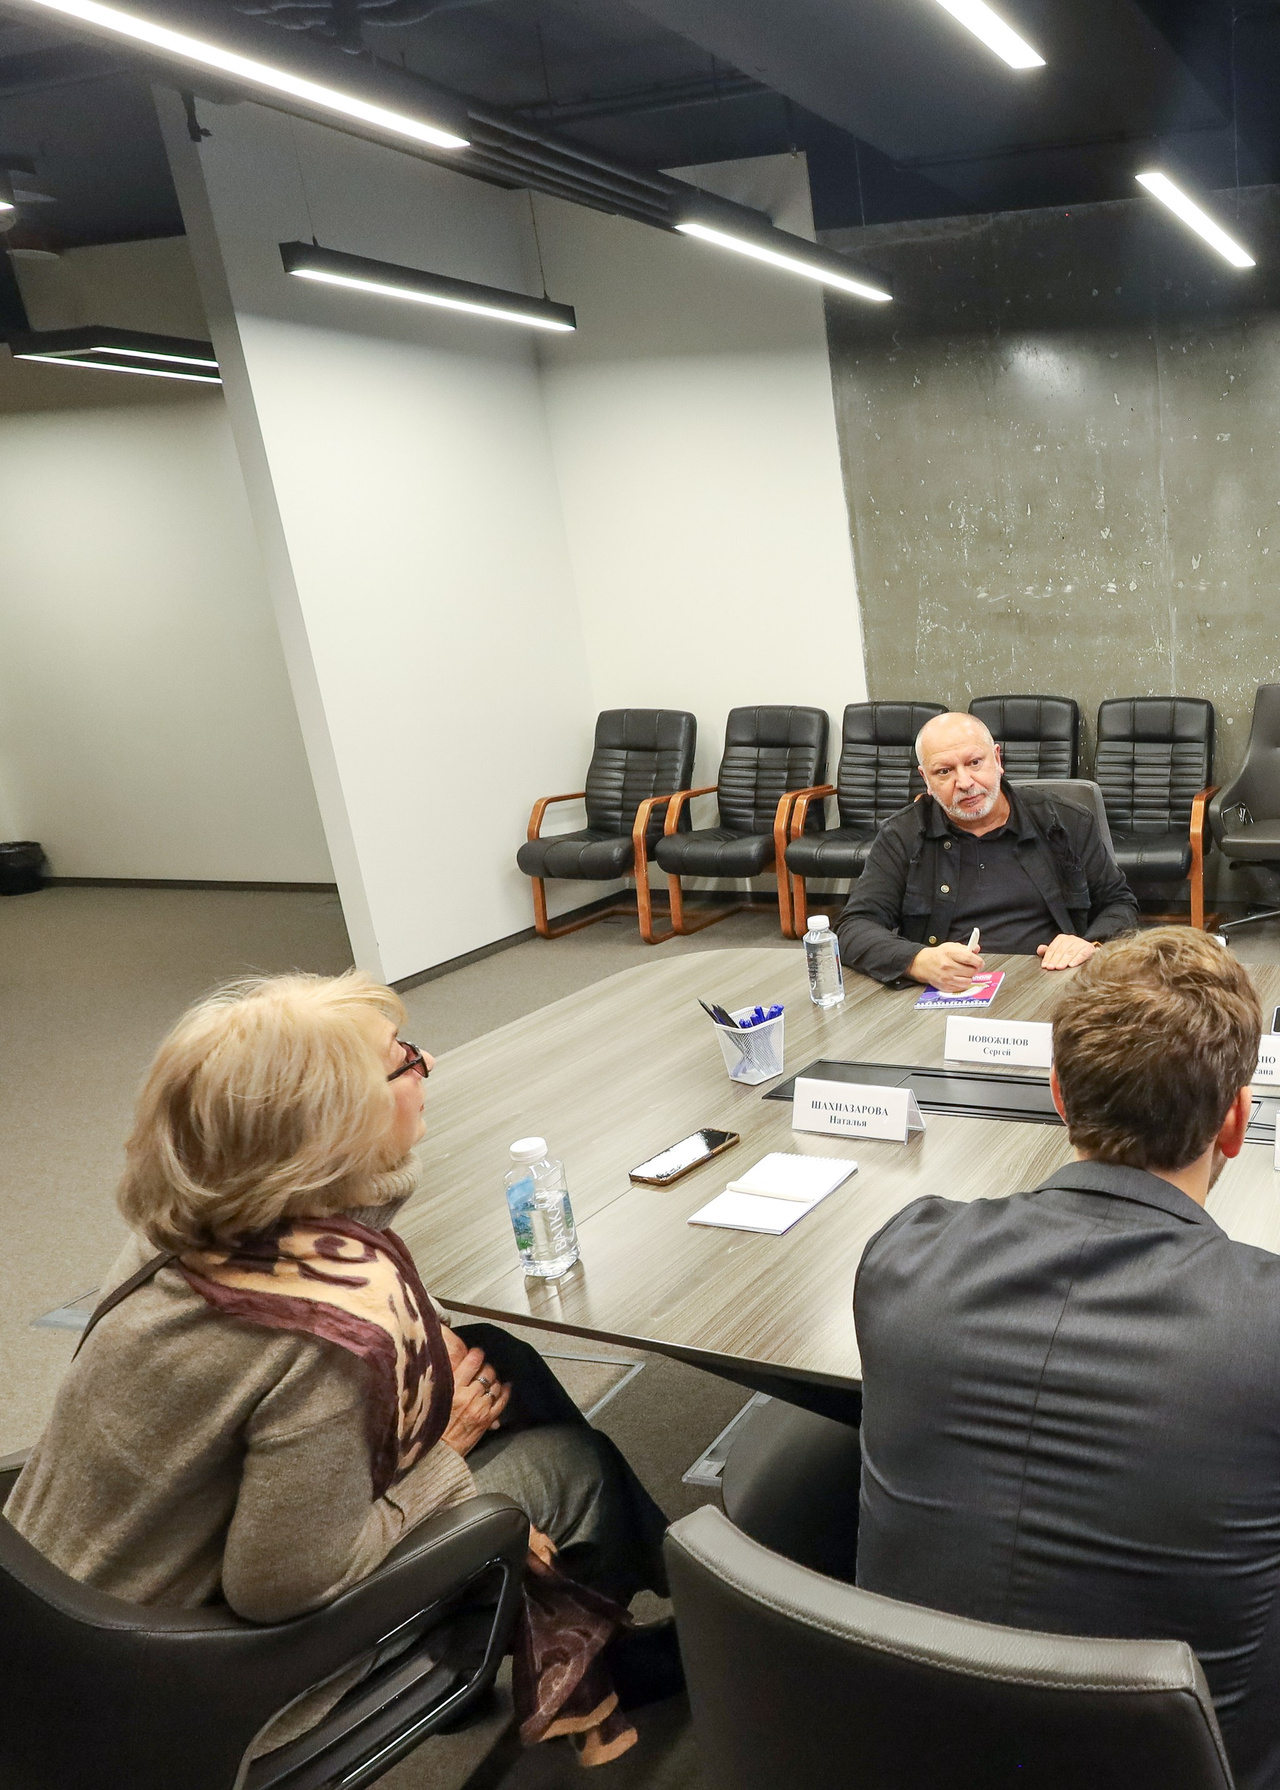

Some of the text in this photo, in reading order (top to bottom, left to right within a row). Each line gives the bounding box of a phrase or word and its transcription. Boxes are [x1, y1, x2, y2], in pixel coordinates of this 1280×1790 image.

[968, 1034, 1029, 1047] НОВОЖИЛОВ
[983, 1046, 1011, 1057] Сергей
[811, 1100, 889, 1116] ШАХНАЗАРОВА
[829, 1115, 867, 1127] Наталья
[547, 1195, 568, 1253] BAIKA
